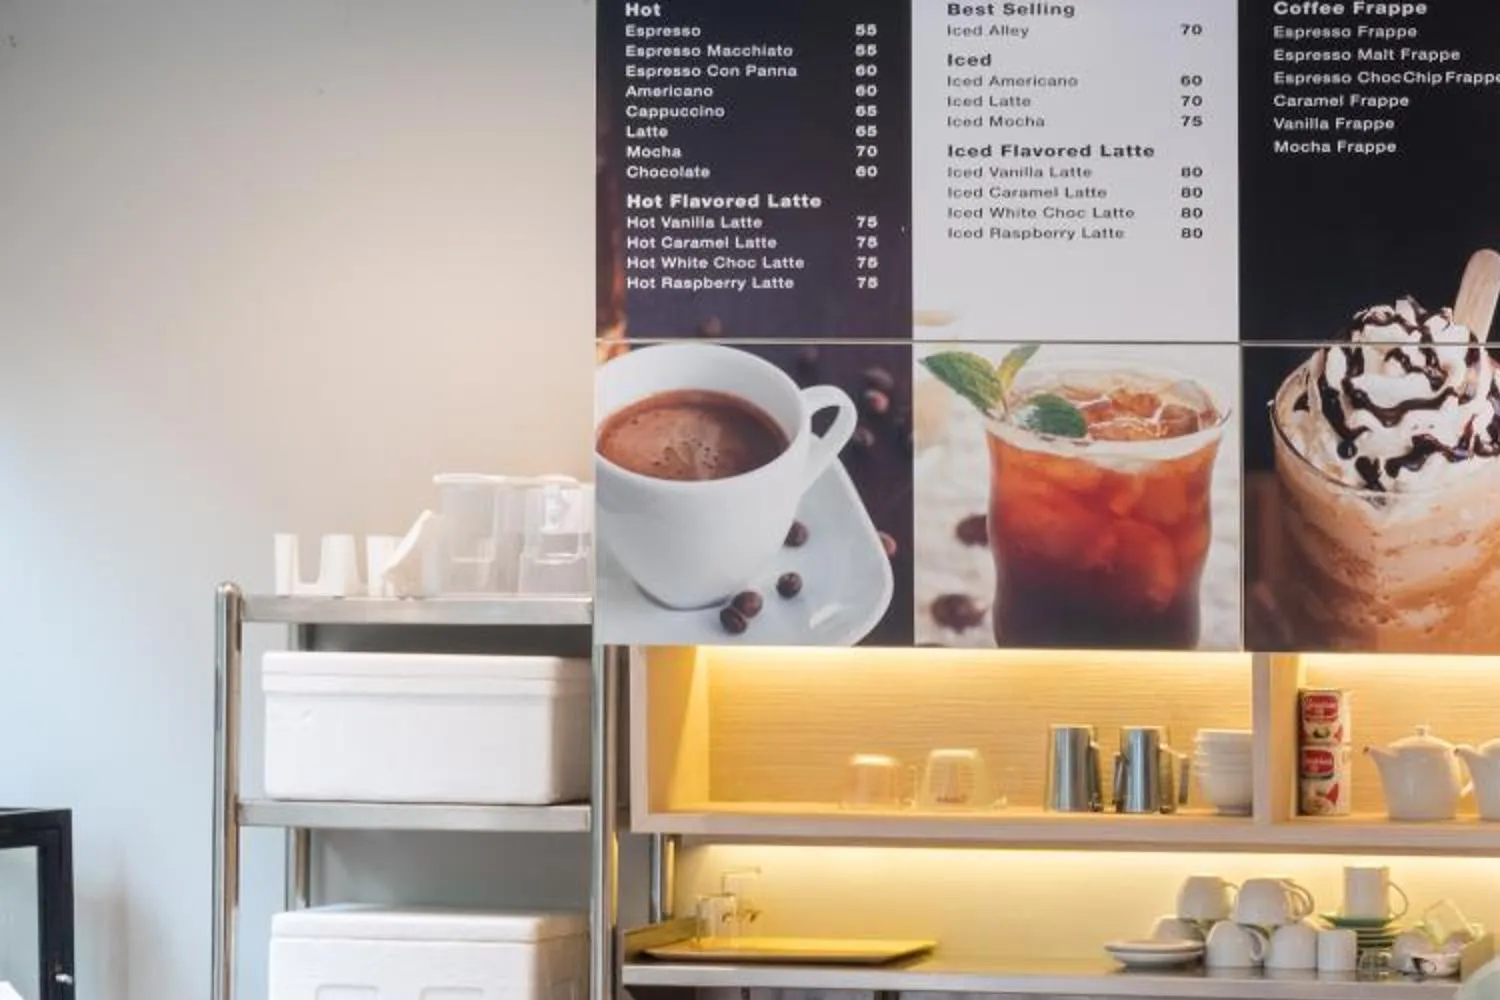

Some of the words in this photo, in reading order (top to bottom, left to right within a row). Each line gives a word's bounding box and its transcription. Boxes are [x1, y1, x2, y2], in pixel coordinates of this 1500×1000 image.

[625, 2, 660, 16] Hot
[948, 3, 994, 16] Best
[1003, 3, 1075, 18] Selling
[1274, 1, 1344, 15] Coffee
[1354, 0, 1427, 16] Frappe
[626, 24, 701, 38] Espresso
[947, 24, 982, 36] Iced
[989, 25, 1029, 39] Alley
[1182, 24, 1202, 35] 70
[1274, 26, 1351, 40] Espresso
[1358, 26, 1417, 40] Frappe
[626, 45, 701, 58] Espresso
[707, 44, 793, 57] Macchiato
[1274, 49, 1351, 63] Espresso
[1358, 48, 1394, 60] Malt
[1401, 48, 1460, 62] Frappe
[947, 53, 992, 67] Iced
[626, 65, 701, 79] Espresso
[707, 64, 740, 76] Con
[746, 64, 797, 77] Panna
[625, 85, 713, 97] Americano
[947, 96, 983, 107] Iced
[989, 96, 1031, 107] Latte
[1181, 95, 1202, 106] 70
[1274, 94, 1344, 107] Caramel
[1350, 94, 1409, 109] Frappe
[626, 105, 725, 120] Cappuccino
[948, 116, 982, 127] Iced
[990, 116, 1044, 127] Mocha
[1182, 115, 1202, 126] 75
[1274, 118, 1329, 130] Vanilla
[1336, 117, 1394, 131] Frappe
[626, 125, 668, 138] Latte
[627, 146, 682, 158] Mocha
[856, 145, 878, 157] 70
[948, 144, 992, 157] Iced
[1001, 144, 1091, 157] Flavored
[1100, 144, 1154, 157] Latte
[1274, 140, 1331, 152] Mocha
[1338, 140, 1396, 155] Frappe
[626, 166, 710, 178] Chocolate
[856, 165, 877, 177] 60
[627, 194, 662, 208] Hot
[670, 194, 759, 208] Flavored
[768, 194, 821, 208] Latte
[627, 216, 655, 229] Hot
[661, 216, 714, 228] Vanilla
[721, 216, 762, 228] Latte
[857, 216, 878, 228] 75
[948, 228, 983, 238] Iced
[990, 227, 1075, 240] Raspberry
[1082, 228, 1123, 238] Latte
[1181, 228, 1203, 238] 80
[627, 236, 655, 249] Hot
[661, 236, 728, 249] Caramel
[736, 236, 777, 248] Latte
[627, 257, 655, 268] Hot
[662, 256, 708, 268] White
[714, 256, 756, 268] Choc
[763, 256, 804, 268] Latte
[627, 277, 656, 289] Hot
[662, 277, 746, 291] Raspberry
[752, 277, 794, 288] Latte
